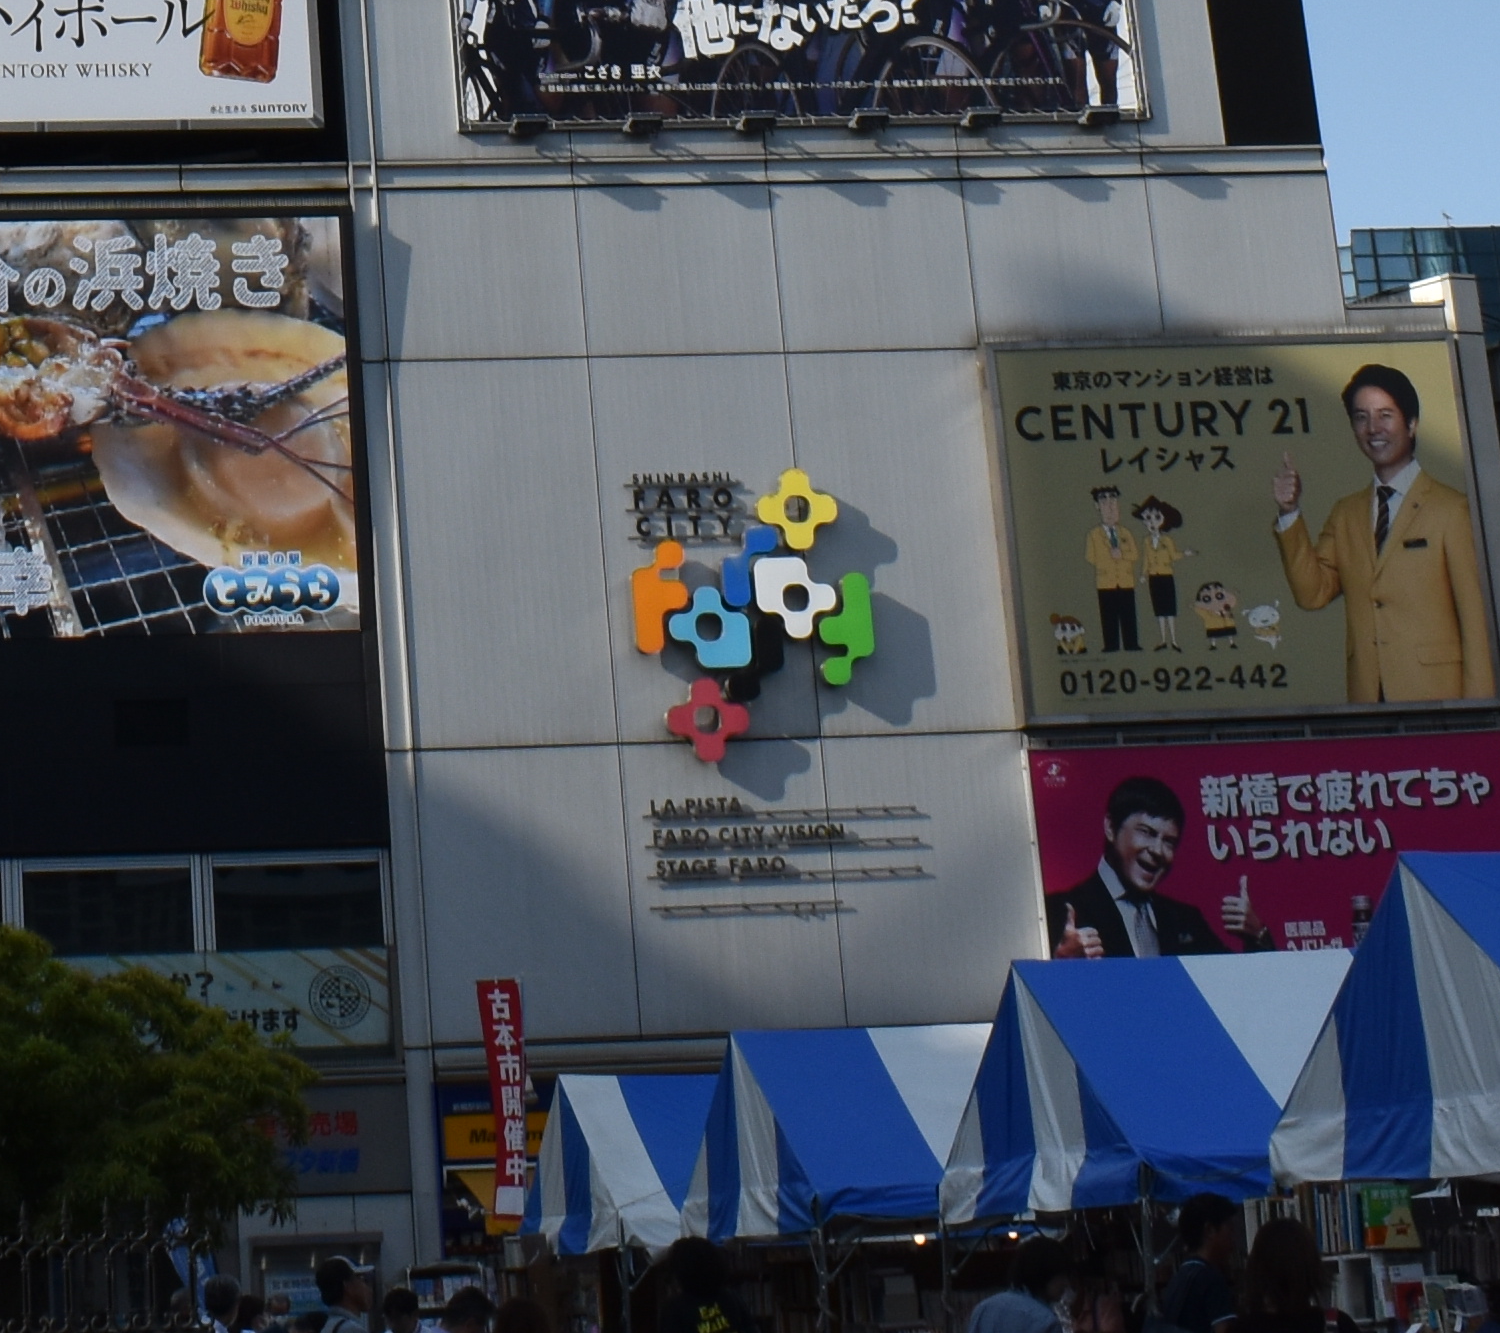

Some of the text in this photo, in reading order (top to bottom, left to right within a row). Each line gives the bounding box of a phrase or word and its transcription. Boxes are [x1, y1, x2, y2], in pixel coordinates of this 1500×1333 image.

[76, 62, 153, 78] WHISKY
[584, 63, 622, 80] こざき
[1051, 366, 1274, 392] 東京のマンション経営は
[1014, 397, 1311, 441] CENTURY 21
[1100, 445, 1236, 474] レイシャス
[632, 471, 733, 484] SHINBASHI
[633, 486, 733, 511] FARO
[636, 514, 732, 537] CITY
[210, 569, 331, 606] とみうら
[1059, 663, 1288, 696] 0120-922-442
[1199, 766, 1491, 819] 新橋で疲れてちゃ
[650, 796, 743, 818] LA PISTA
[652, 823, 845, 847] FARO CITY VISION
[1206, 817, 1393, 861] いられない
[655, 856, 787, 877] STAGE FARO
[486, 988, 526, 1186] 古本市開催中
